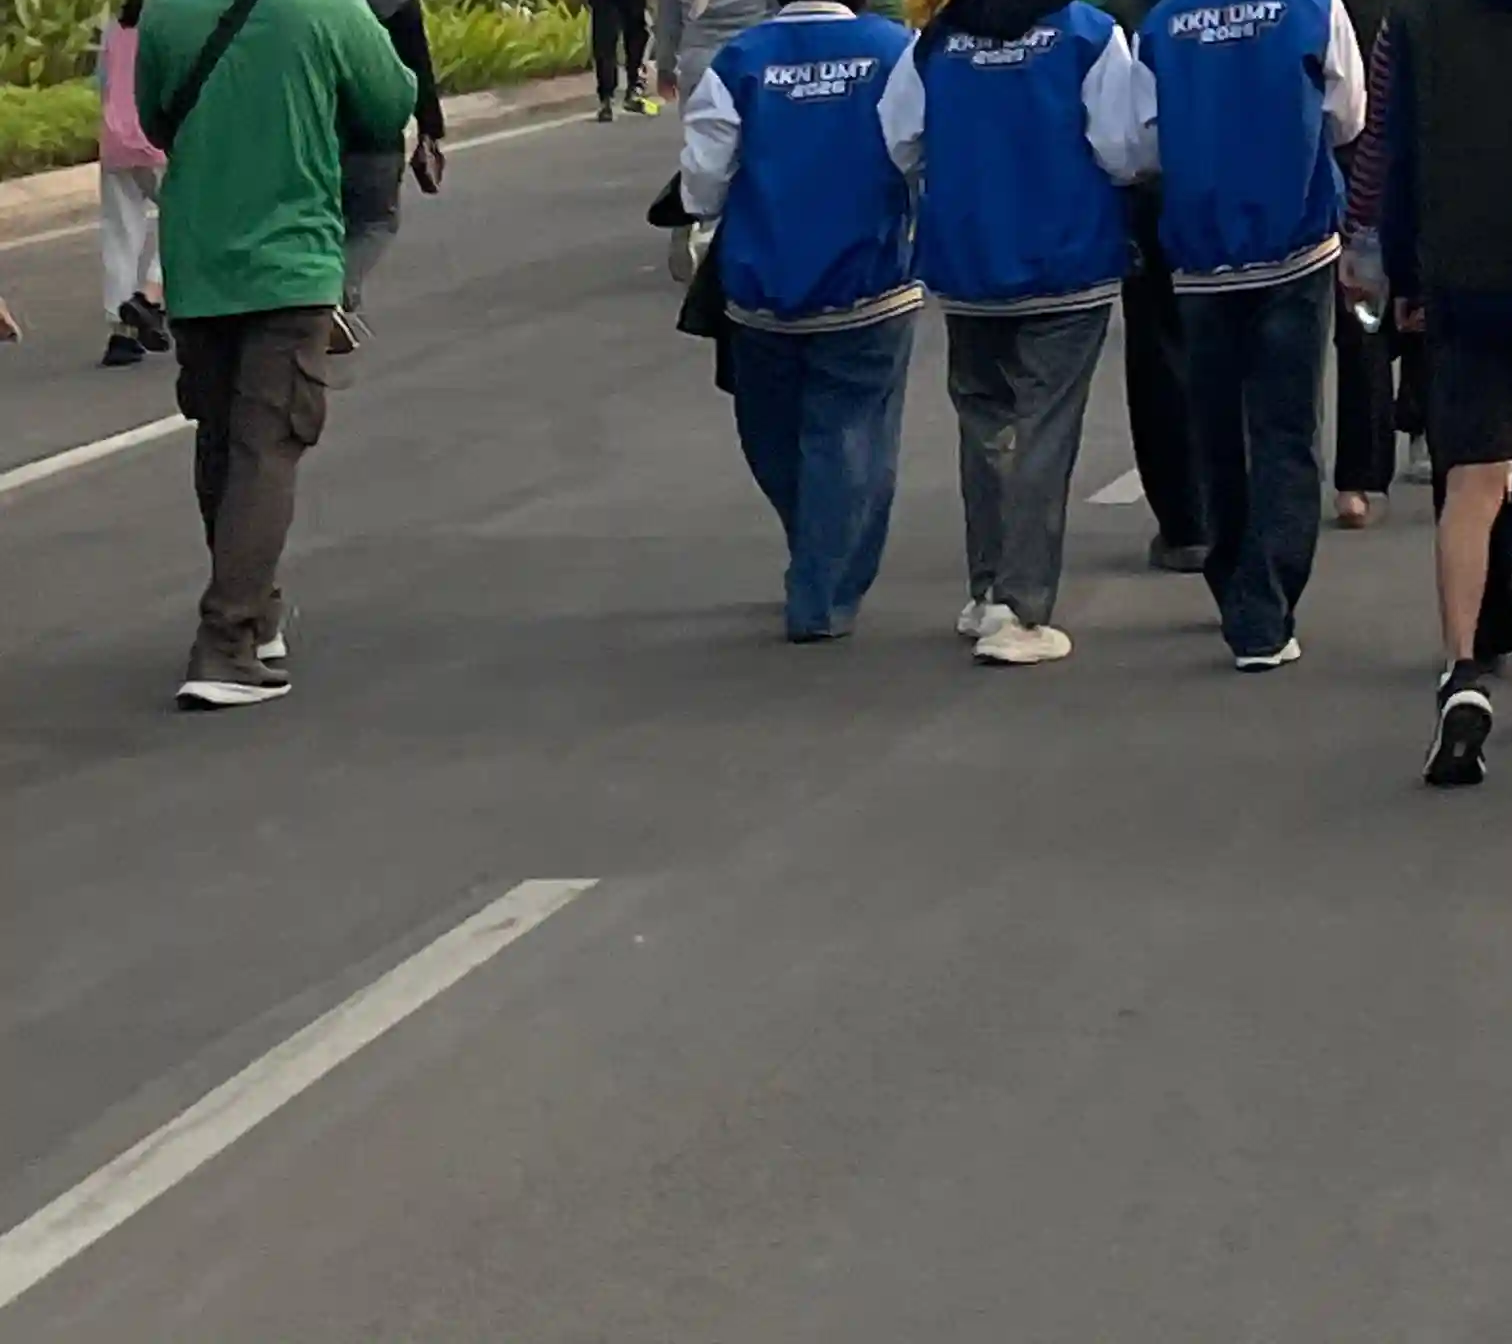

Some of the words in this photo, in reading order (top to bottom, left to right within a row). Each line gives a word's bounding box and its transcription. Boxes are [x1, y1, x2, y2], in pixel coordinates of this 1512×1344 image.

[1171, 9, 1220, 35] KKN
[1229, 1, 1283, 24] UMT
[764, 63, 812, 85] KKN
[819, 59, 873, 81] UMT
